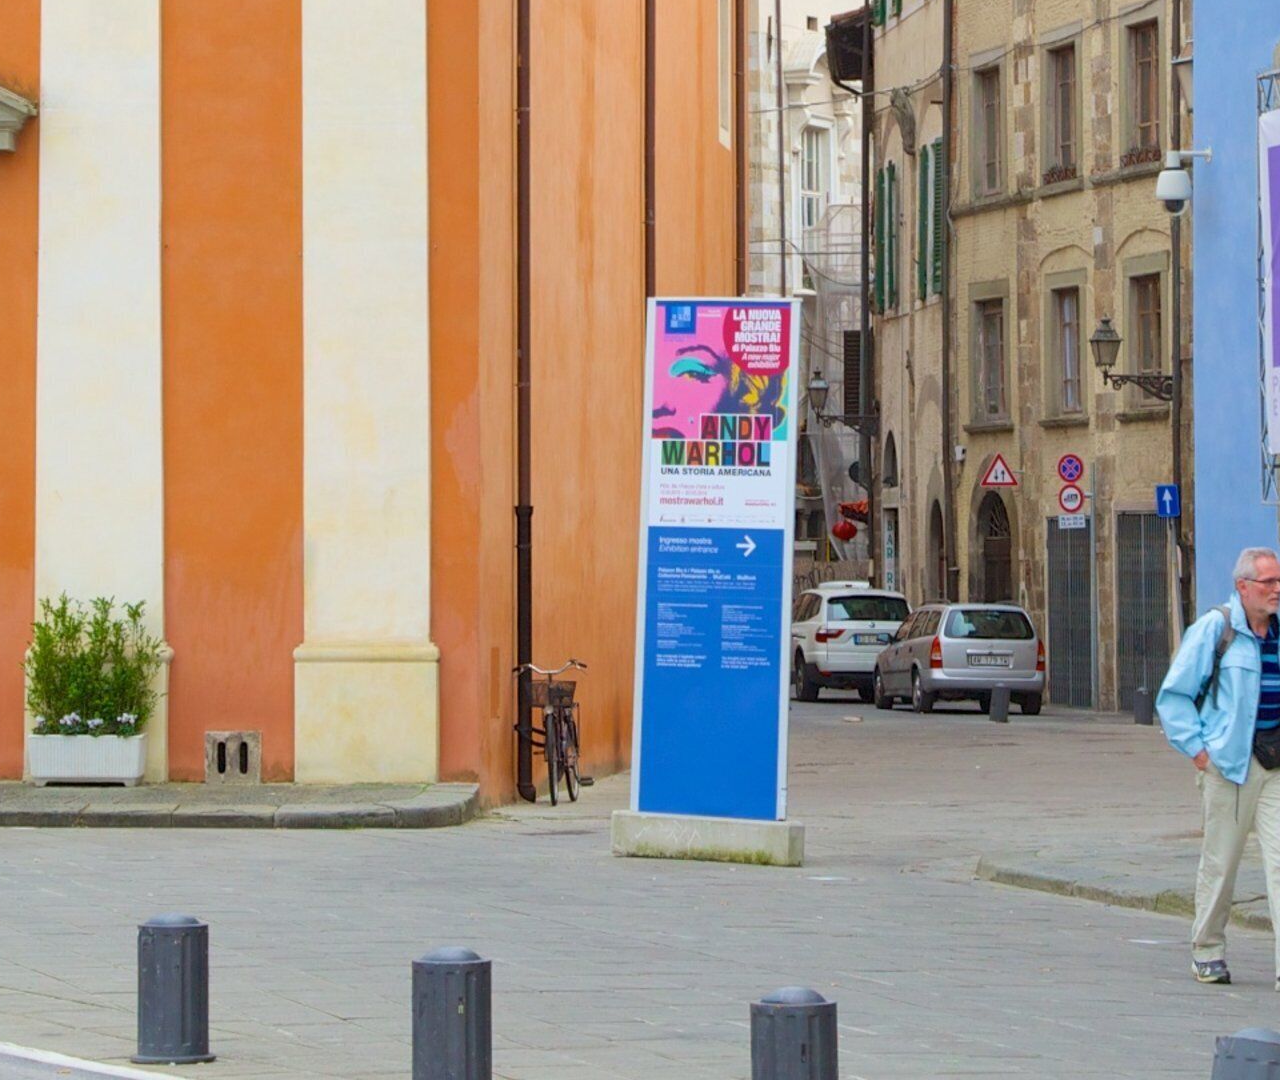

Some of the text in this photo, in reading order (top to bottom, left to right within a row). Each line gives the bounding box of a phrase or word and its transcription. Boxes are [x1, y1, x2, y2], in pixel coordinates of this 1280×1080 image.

[732, 309, 747, 321] LA
[748, 309, 782, 321] NUOVA
[740, 320, 782, 332] GRANDE
[734, 331, 782, 343] MOSTRA!
[1272, 398, 1278, 417] E
[701, 415, 772, 440] ANDY
[661, 440, 771, 467] WARHOL
[660, 467, 772, 477] UNA STORIA AMERICANA
[886, 520, 894, 559] BAR
